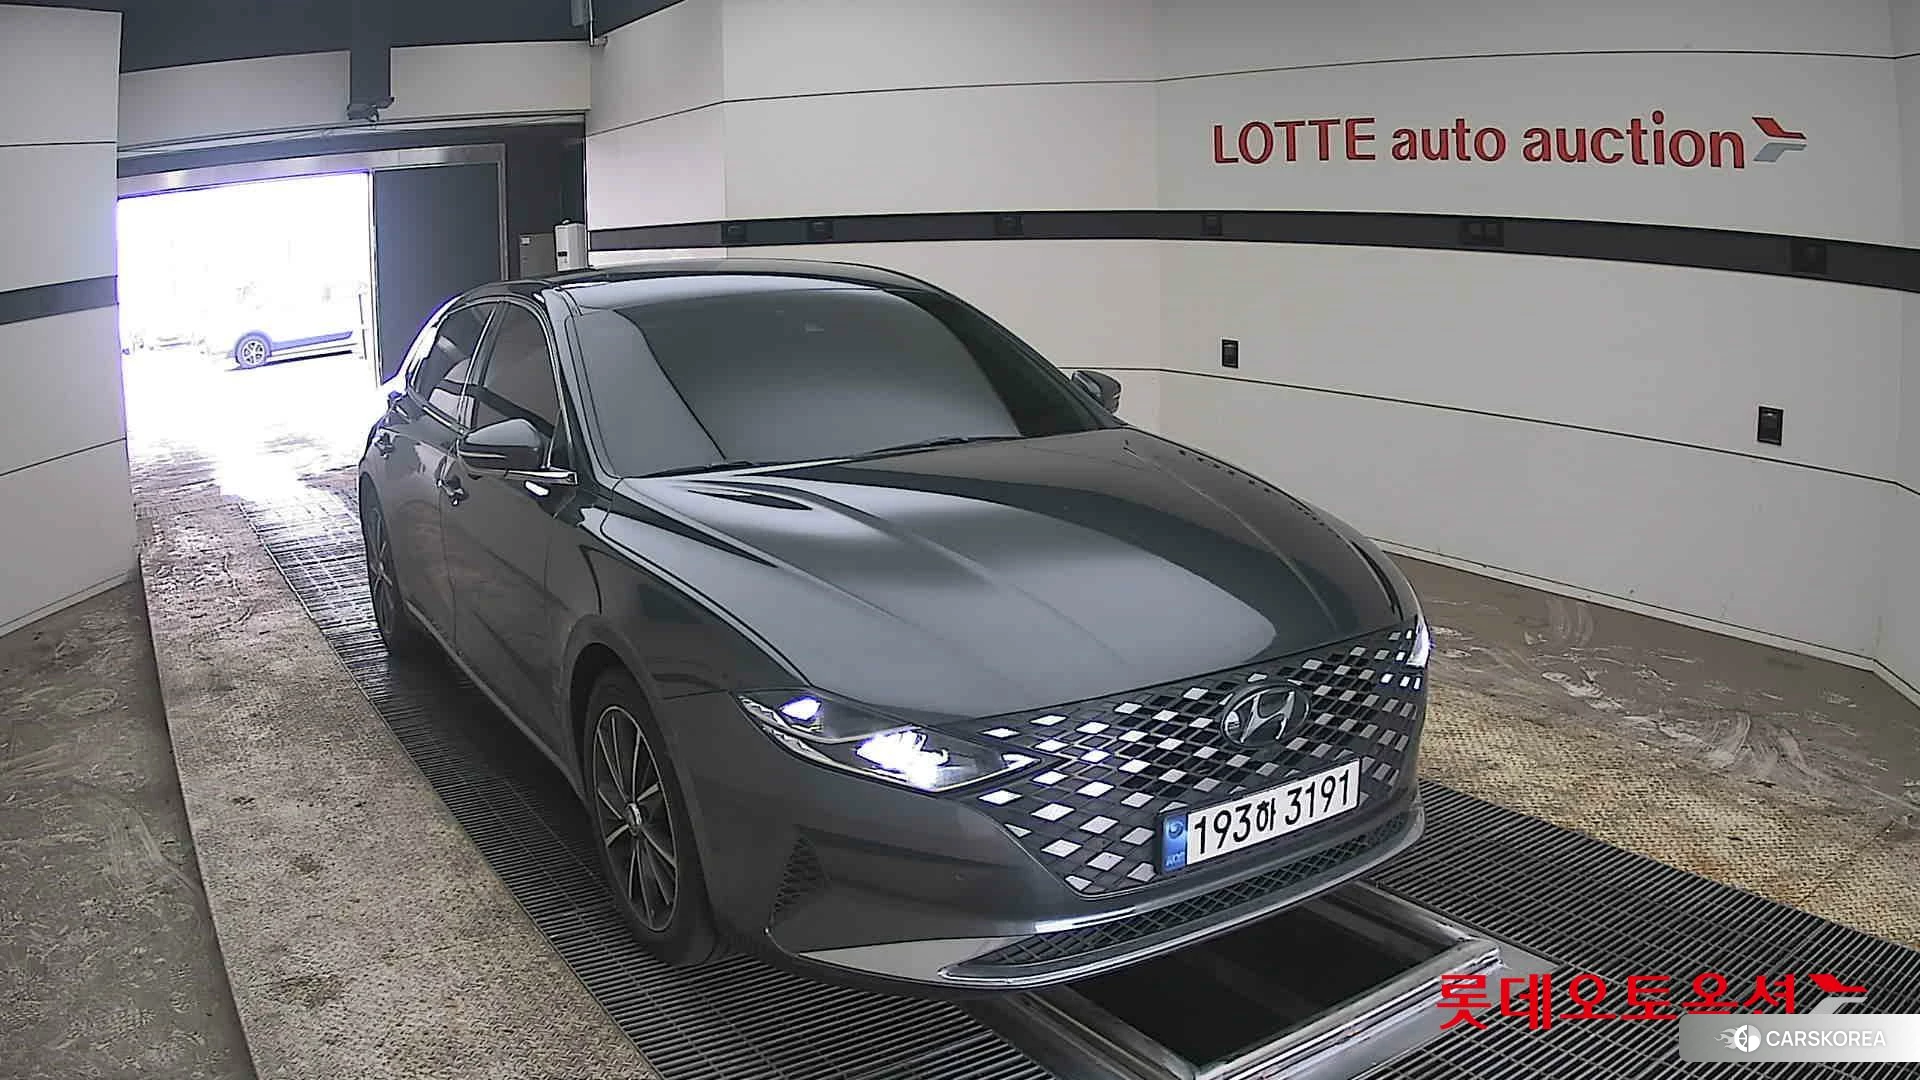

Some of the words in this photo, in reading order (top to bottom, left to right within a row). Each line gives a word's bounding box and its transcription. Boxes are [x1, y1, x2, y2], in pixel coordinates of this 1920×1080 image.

[1212, 117, 1377, 164] LOTTE
[1391, 118, 1508, 162] auto
[1522, 110, 1746, 169] auction
[1194, 798, 1276, 855] 193하
[1285, 769, 1350, 826] 3191
